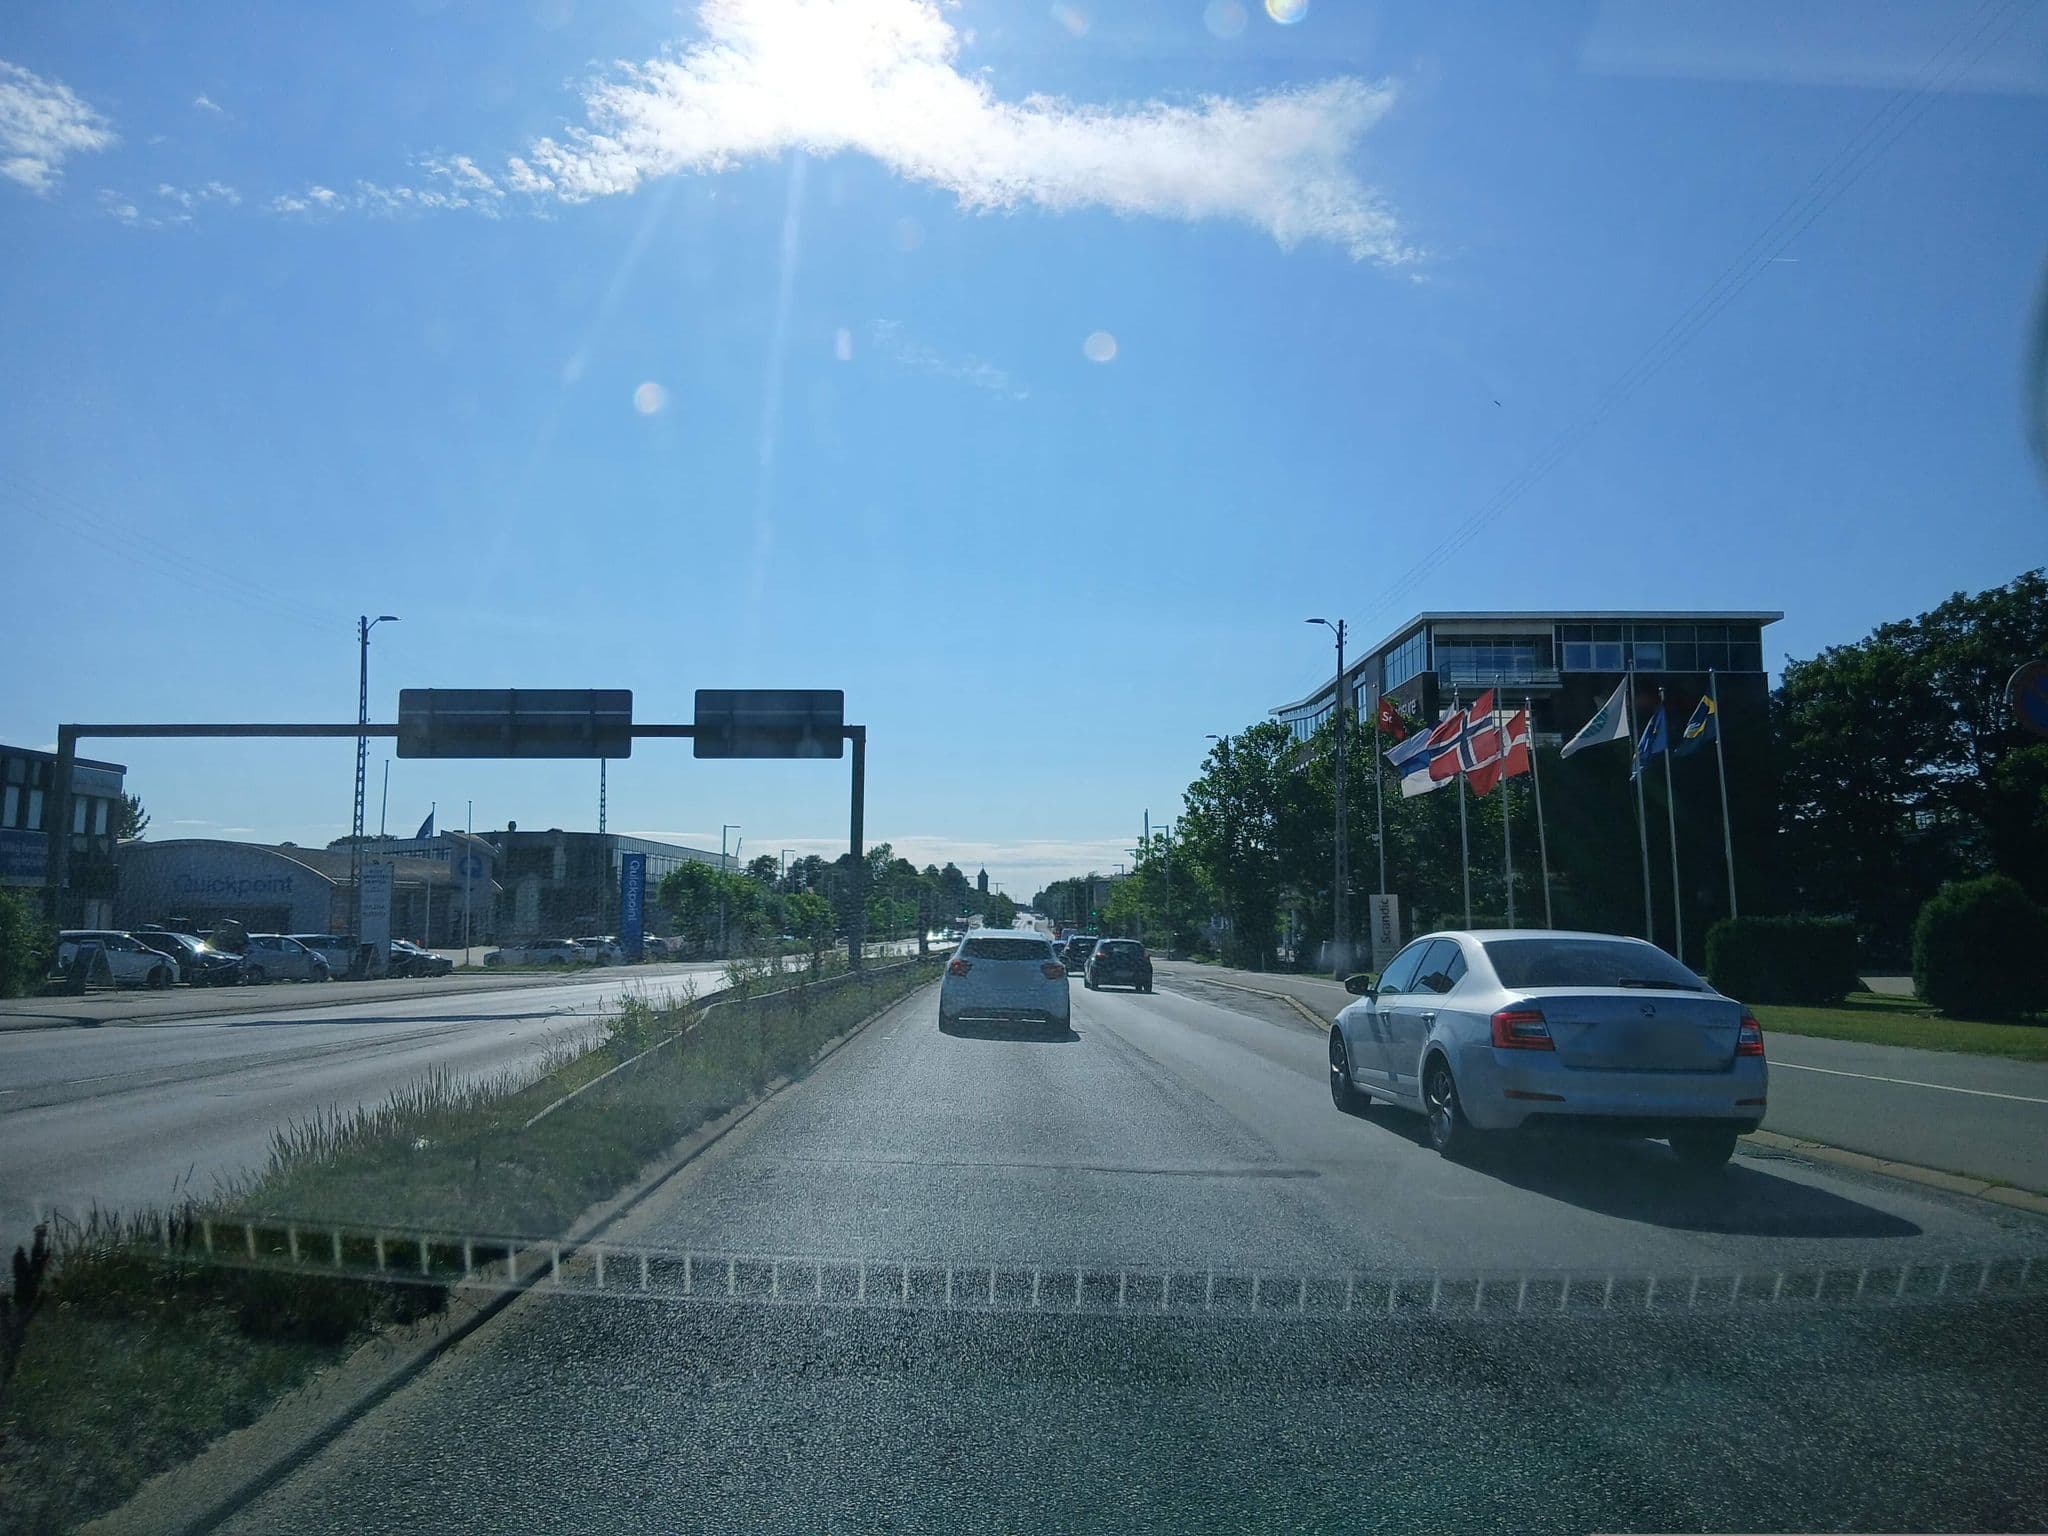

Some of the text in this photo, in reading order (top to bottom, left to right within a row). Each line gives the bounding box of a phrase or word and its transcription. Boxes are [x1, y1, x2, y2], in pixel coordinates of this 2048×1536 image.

[176, 873, 293, 896] Quickpoint
[627, 860, 641, 921] Quickpoint
[1378, 897, 1392, 944] Scandic
